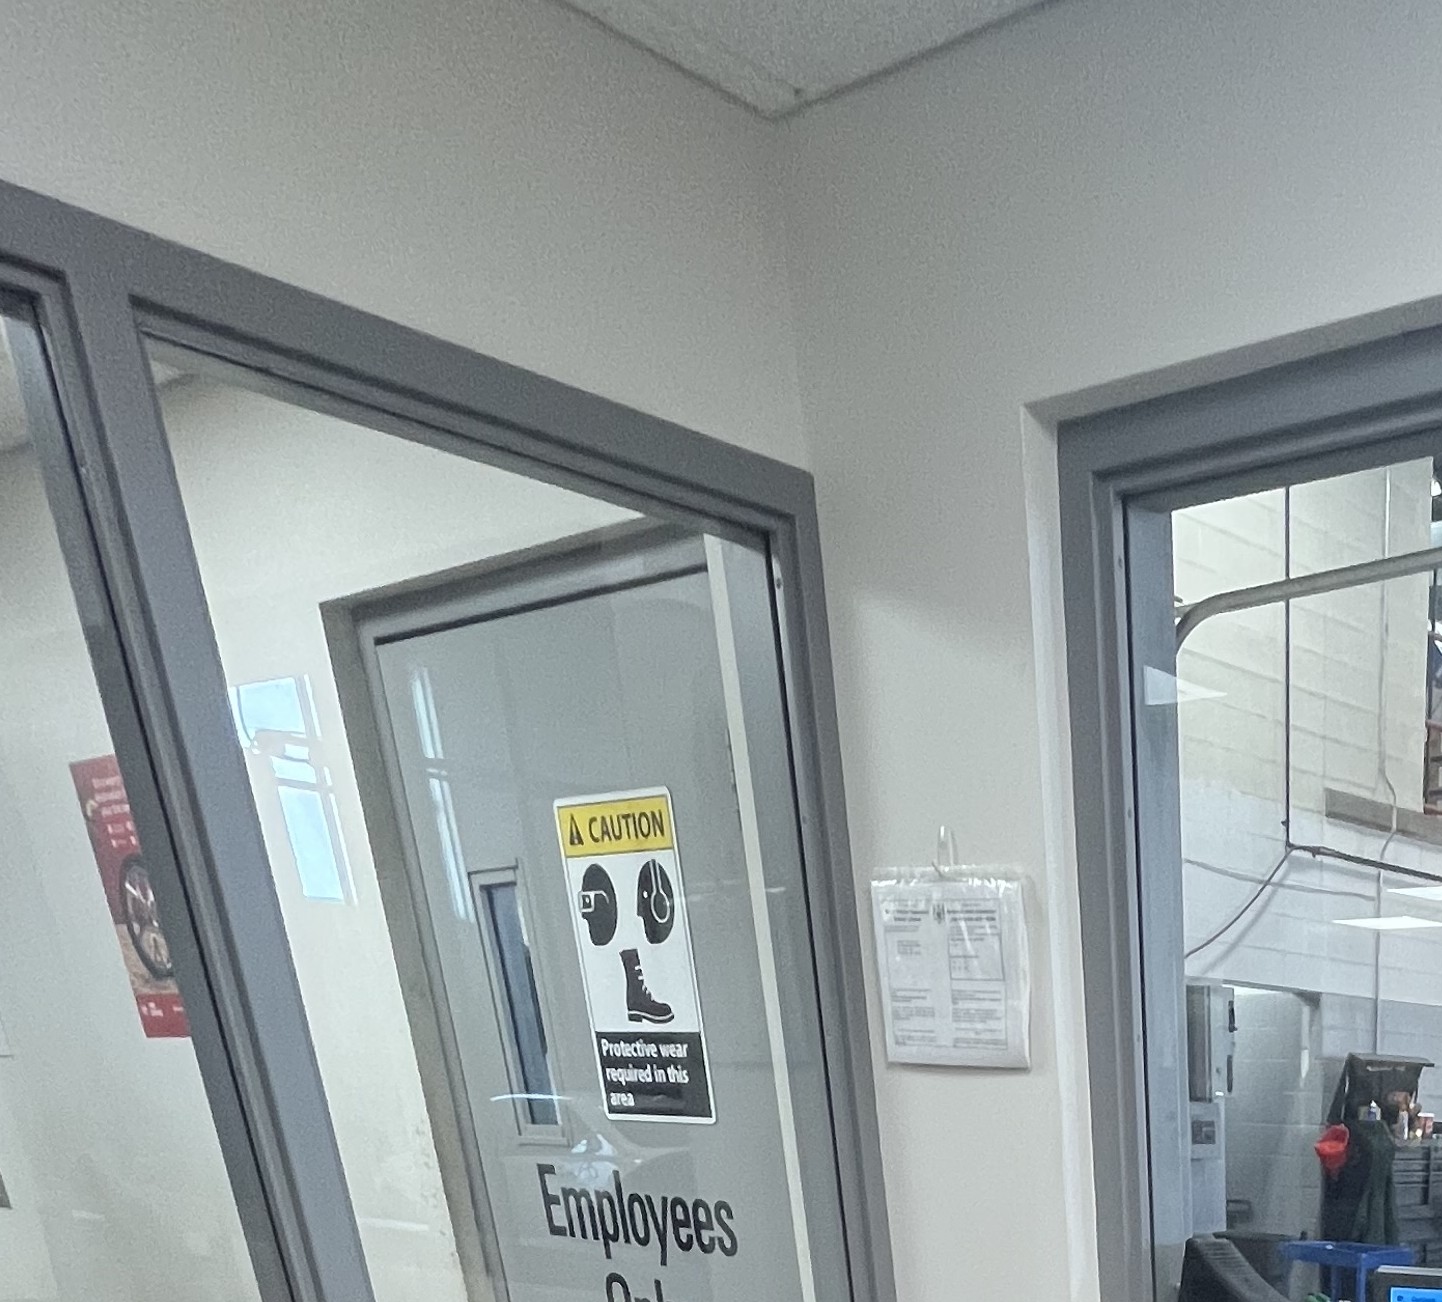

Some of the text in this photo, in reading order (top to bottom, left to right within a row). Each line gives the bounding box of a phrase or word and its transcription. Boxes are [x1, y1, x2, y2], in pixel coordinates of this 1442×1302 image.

[588, 809, 664, 843] CAUTION
[601, 1038, 688, 1057] Protective wear
[605, 1063, 689, 1086] required in this
[610, 1092, 635, 1106] area
[536, 1163, 738, 1266] Employees
